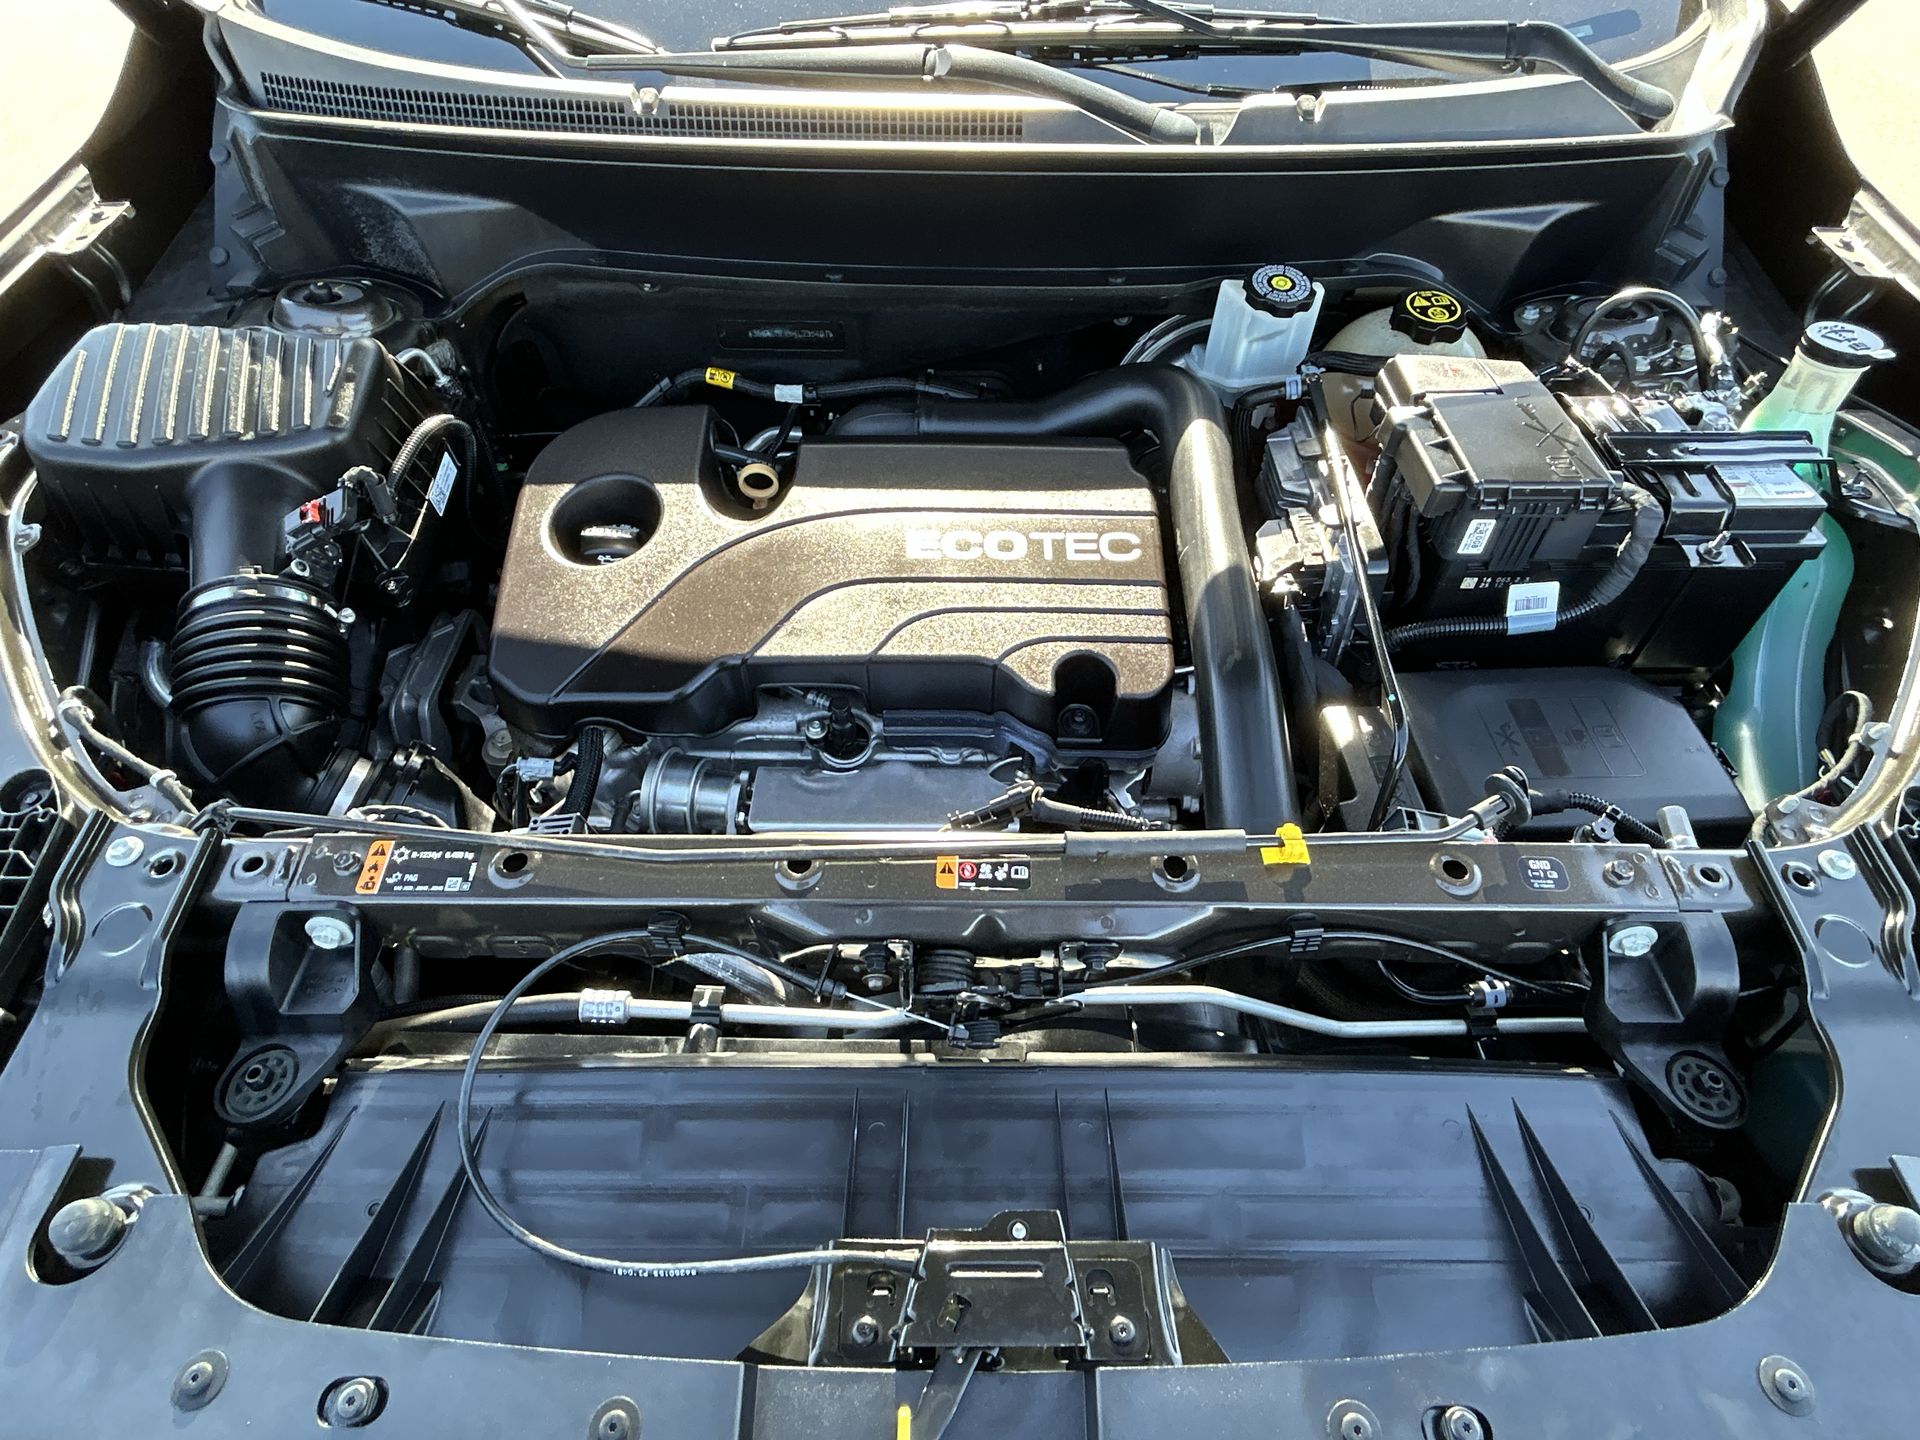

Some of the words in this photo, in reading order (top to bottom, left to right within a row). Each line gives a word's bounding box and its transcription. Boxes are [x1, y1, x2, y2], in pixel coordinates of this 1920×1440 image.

[905, 530, 1142, 561] ECOTEC
[1529, 860, 1551, 870] GND
[403, 873, 419, 882] PAG
